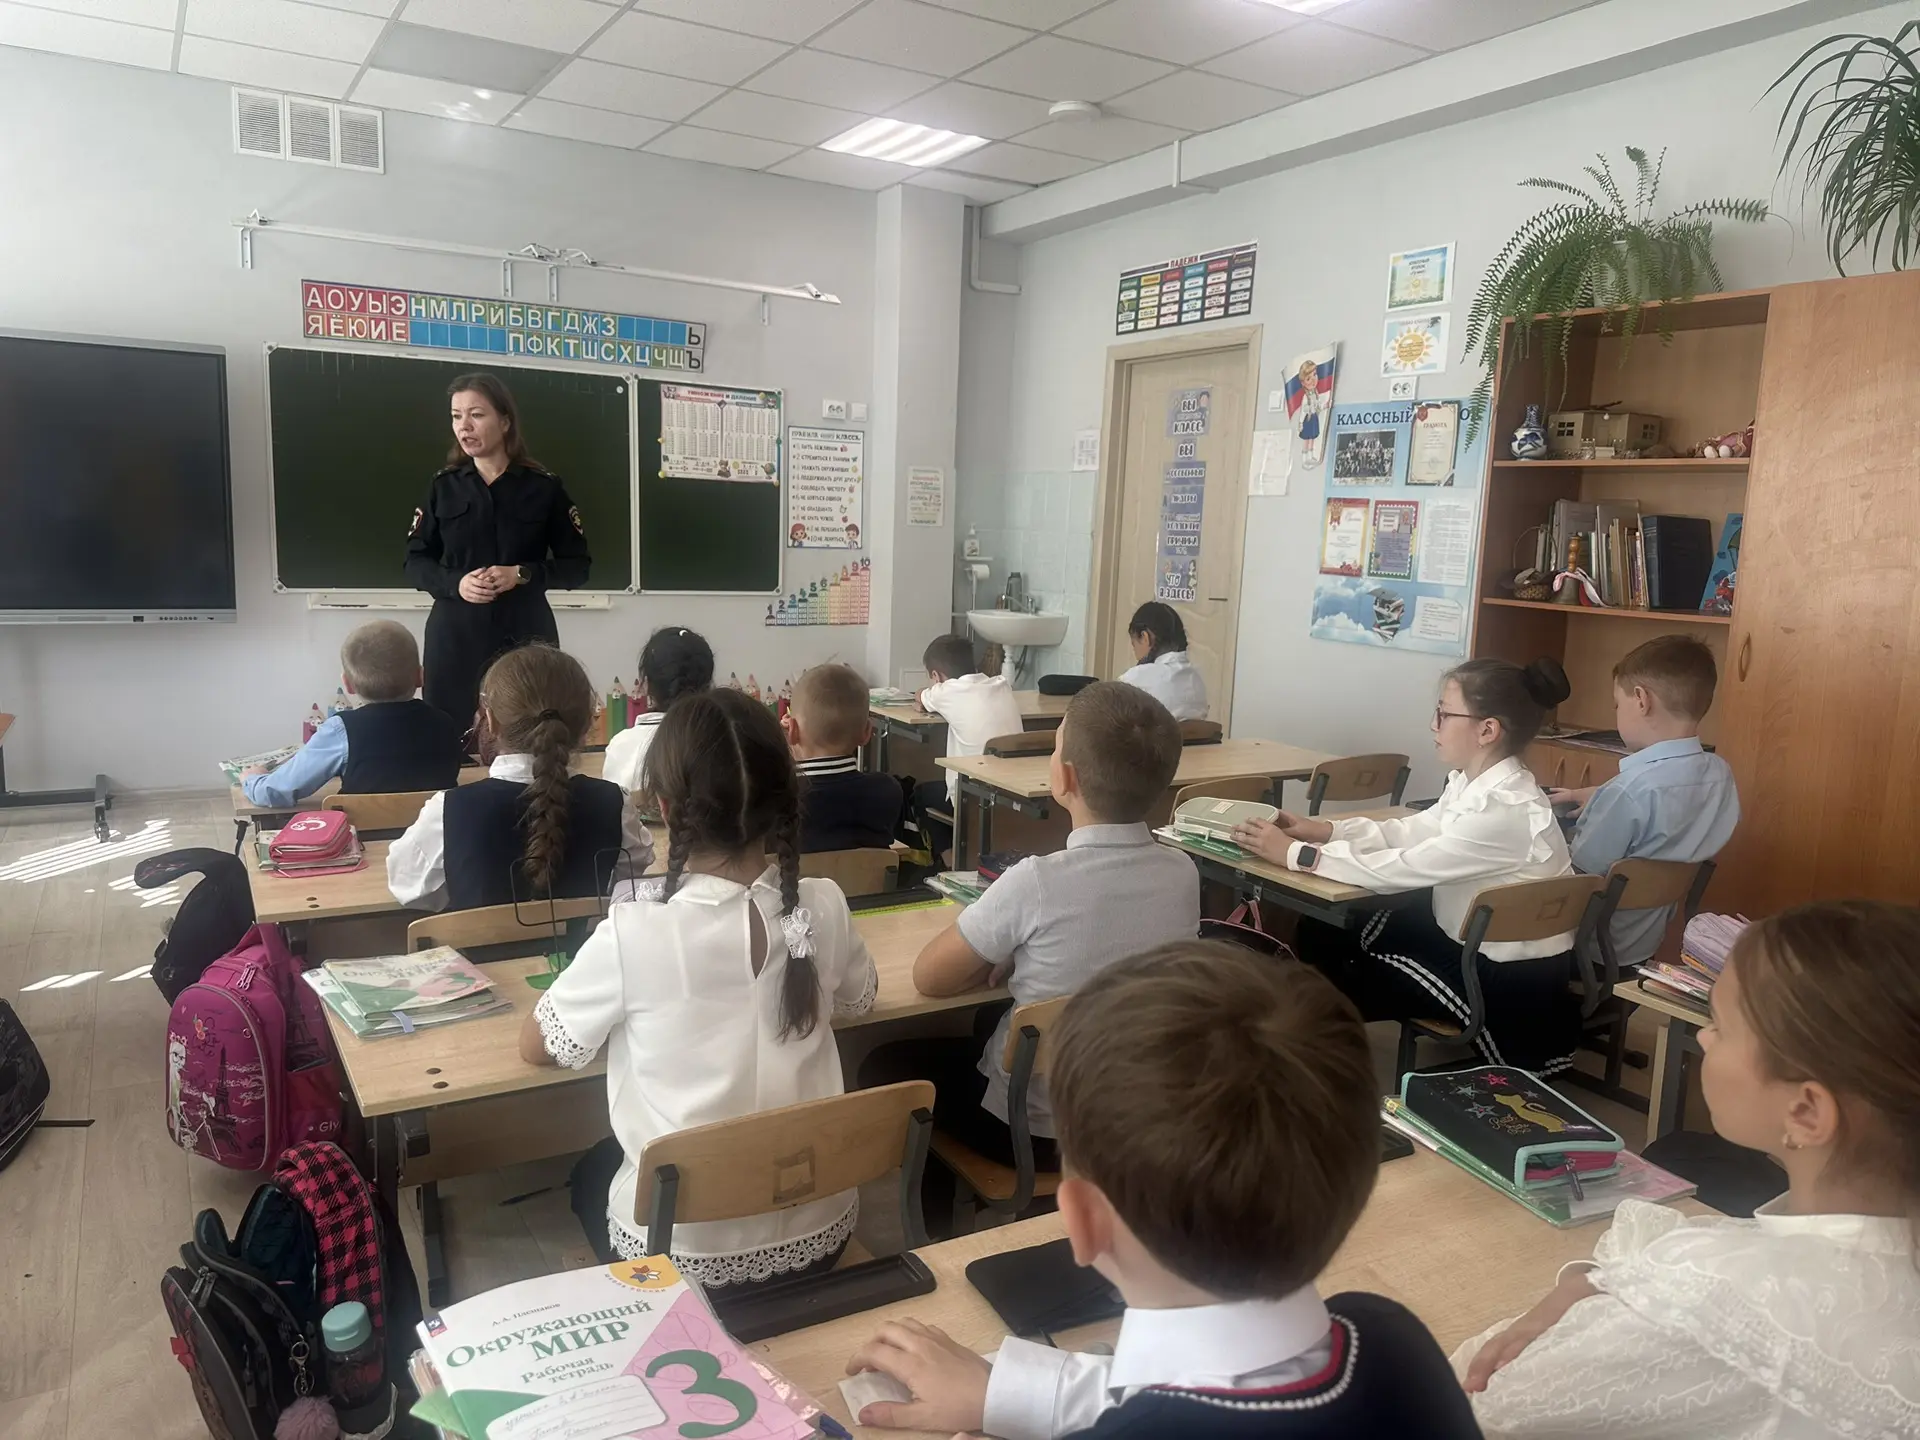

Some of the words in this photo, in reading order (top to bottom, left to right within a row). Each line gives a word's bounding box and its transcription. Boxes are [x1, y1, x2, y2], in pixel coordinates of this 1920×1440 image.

[1182, 399, 1197, 412] ВЫ
[1336, 407, 1413, 426] КЛАССНЫЙ
[1174, 420, 1202, 434] КЛАСС
[1179, 444, 1194, 456] ВЫ
[851, 560, 859, 572] 9
[860, 557, 871, 567] 10
[810, 582, 817, 592] 5
[820, 577, 828, 588] 6
[767, 604, 773, 615] 1
[778, 599, 785, 610] 2
[446, 1299, 654, 1367] Окружающий
[526, 1320, 630, 1361] МИР
[520, 1356, 596, 1384] Рабочая
[548, 1362, 614, 1384] тетрадь
[645, 1349, 757, 1438] 3
